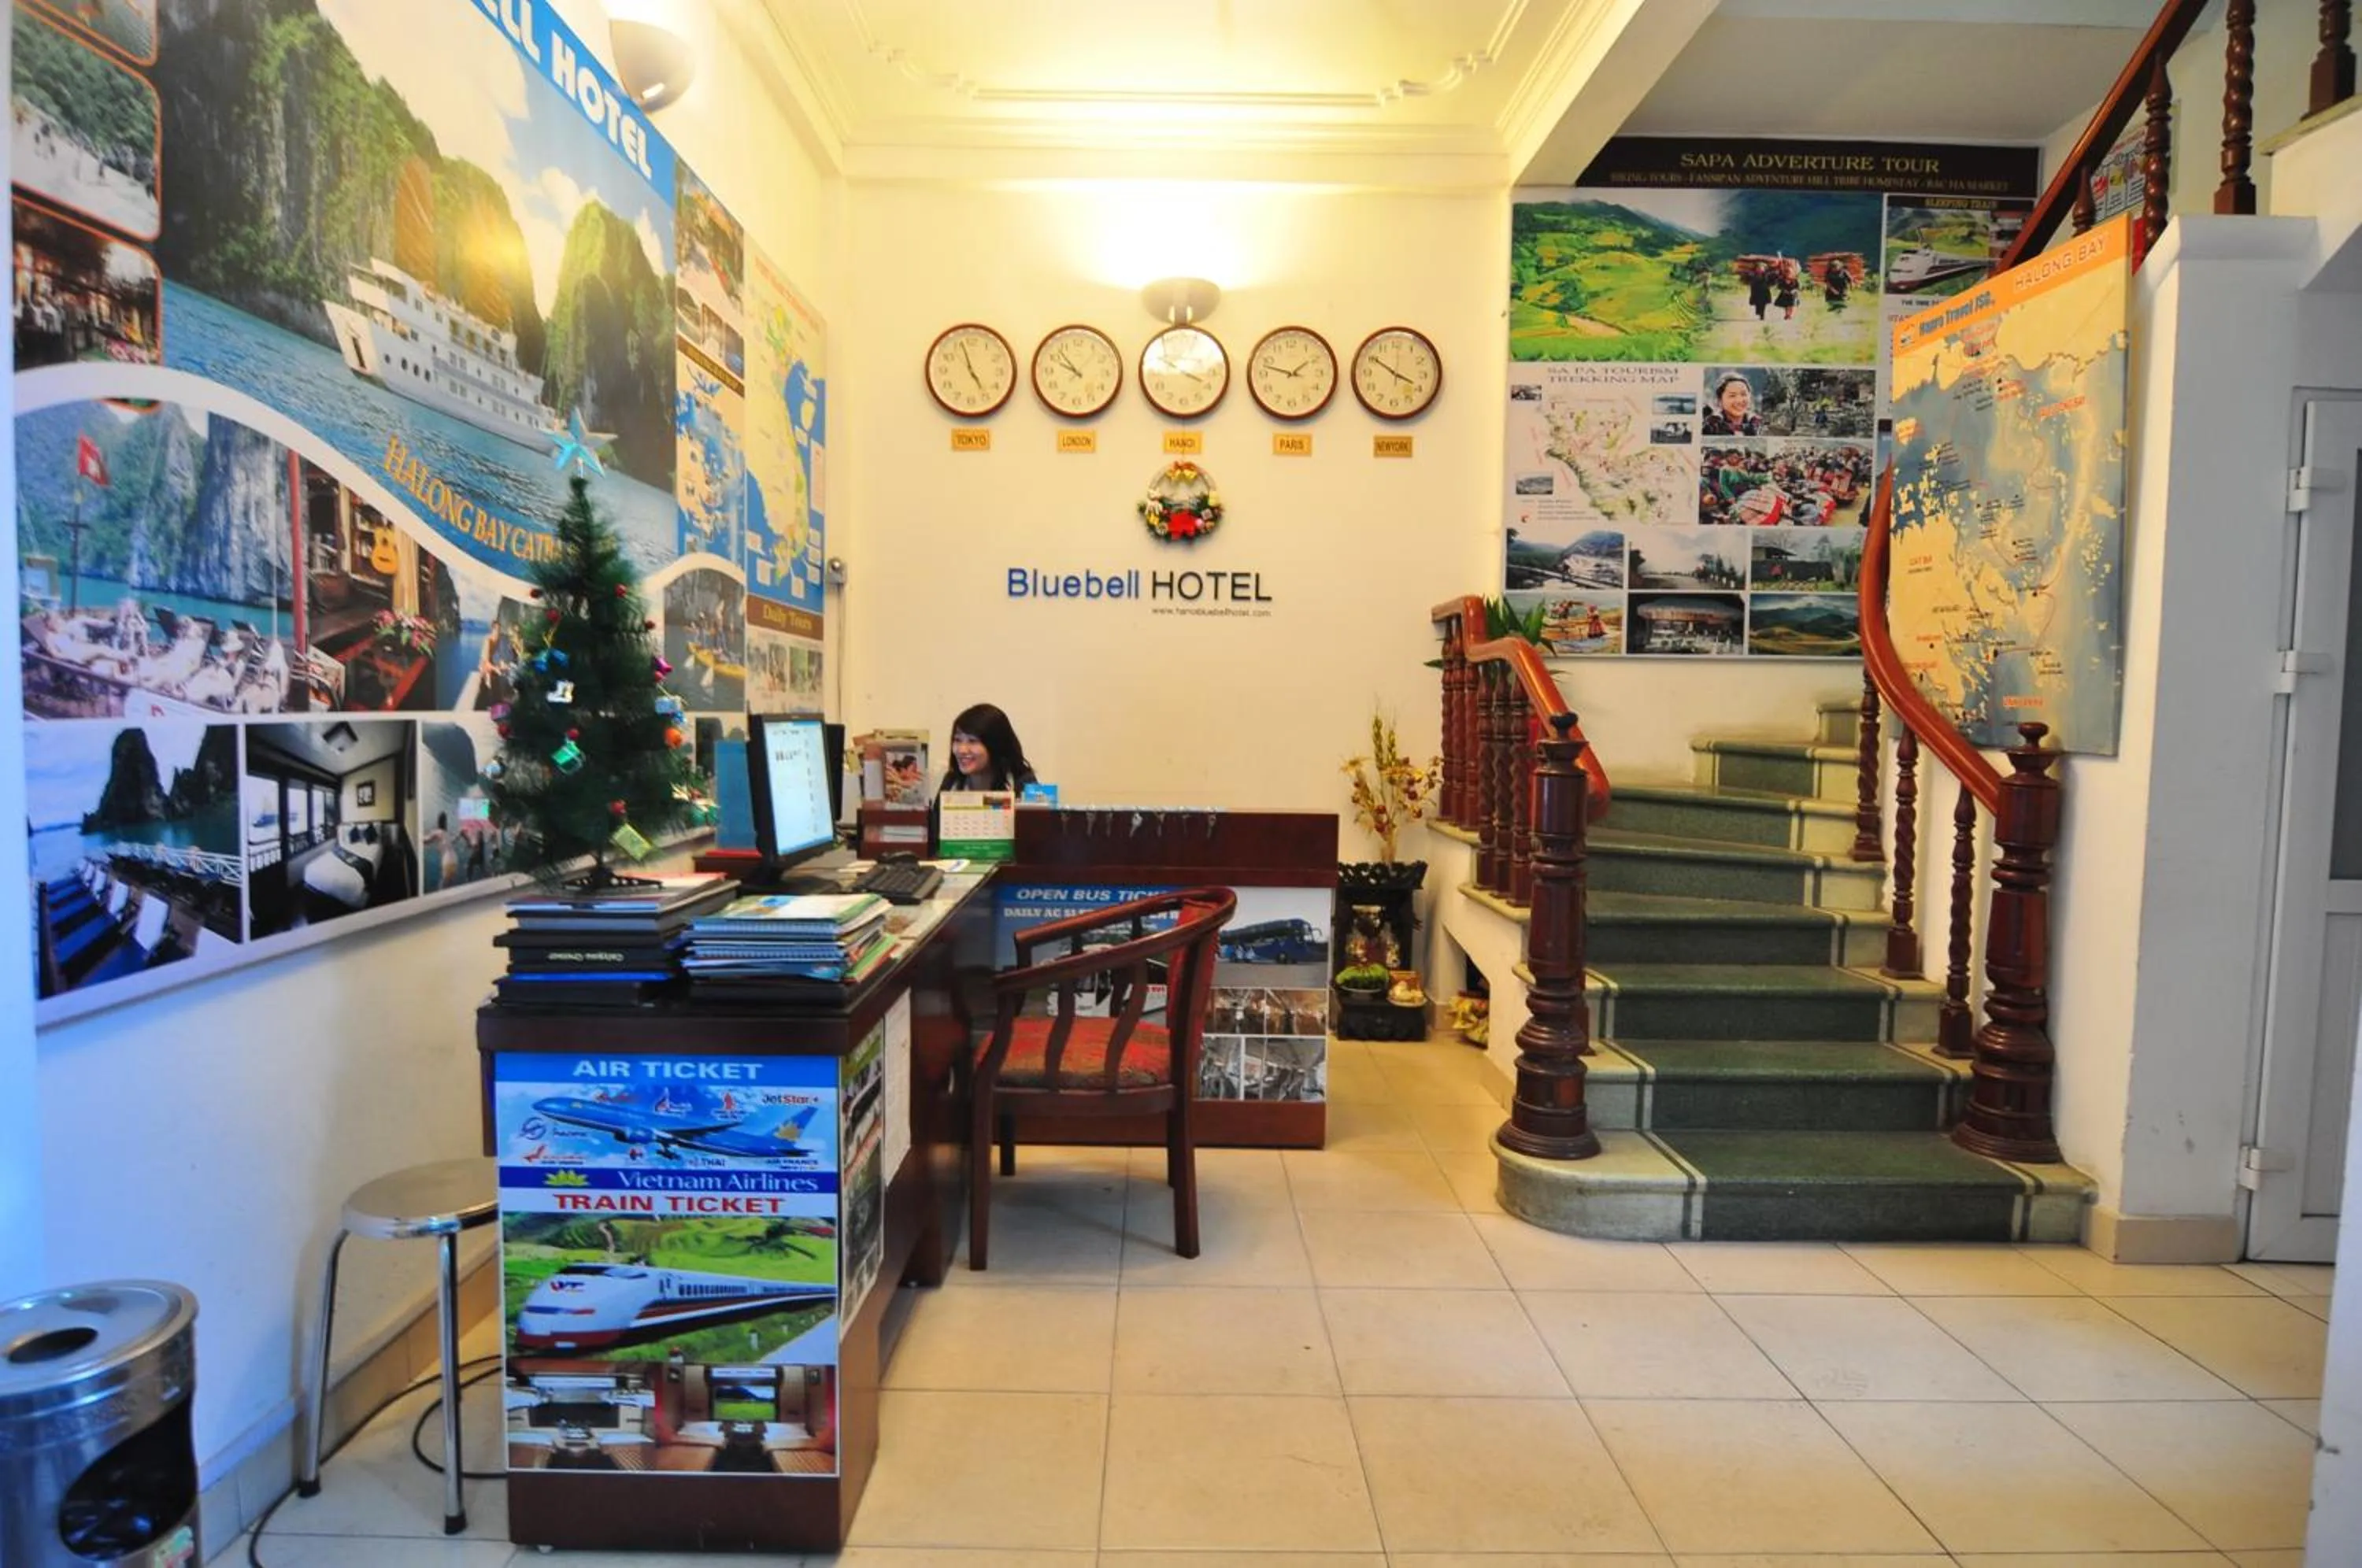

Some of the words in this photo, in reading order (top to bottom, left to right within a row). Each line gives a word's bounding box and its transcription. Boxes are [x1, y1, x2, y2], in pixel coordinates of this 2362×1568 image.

[552, 30, 652, 180] HOTEL
[1679, 153, 1734, 168] SAPA
[1742, 155, 1875, 171] ADVERTURE
[1883, 157, 1940, 173] TOUR
[2013, 252, 2074, 291] HALONG
[2076, 235, 2107, 263] BAY
[1547, 367, 1569, 375] SA
[1575, 367, 1596, 375] PA
[1602, 367, 1679, 375] TOURISM
[1549, 375, 1636, 384] TREKKING
[1640, 376, 1680, 385] MAP
[955, 435, 987, 446] TOKYO
[1062, 436, 1092, 448] LONDON
[1169, 438, 1196, 449] HANOI
[1279, 439, 1304, 450] PARIS
[1378, 441, 1409, 452] NEWYORK
[383, 435, 474, 534] HALONG
[474, 508, 512, 552] BAY
[1007, 568, 1139, 599] Bluebell
[1152, 570, 1273, 602] HOTEL
[763, 604, 787, 627] Daily
[1016, 888, 1068, 900] OPEN
[1072, 889, 1112, 901] BUS
[1117, 889, 1171, 902] TIC
[1003, 907, 1043, 918] DAILY
[1043, 908, 1062, 919] AC
[572, 1060, 631, 1078] AIR
[639, 1060, 765, 1080] TICKET
[702, 1158, 726, 1167] THAI
[616, 1170, 722, 1189] Vietnam
[724, 1173, 820, 1192] Airlines
[552, 1193, 653, 1211] TRAIN
[665, 1196, 786, 1214] TICKET
